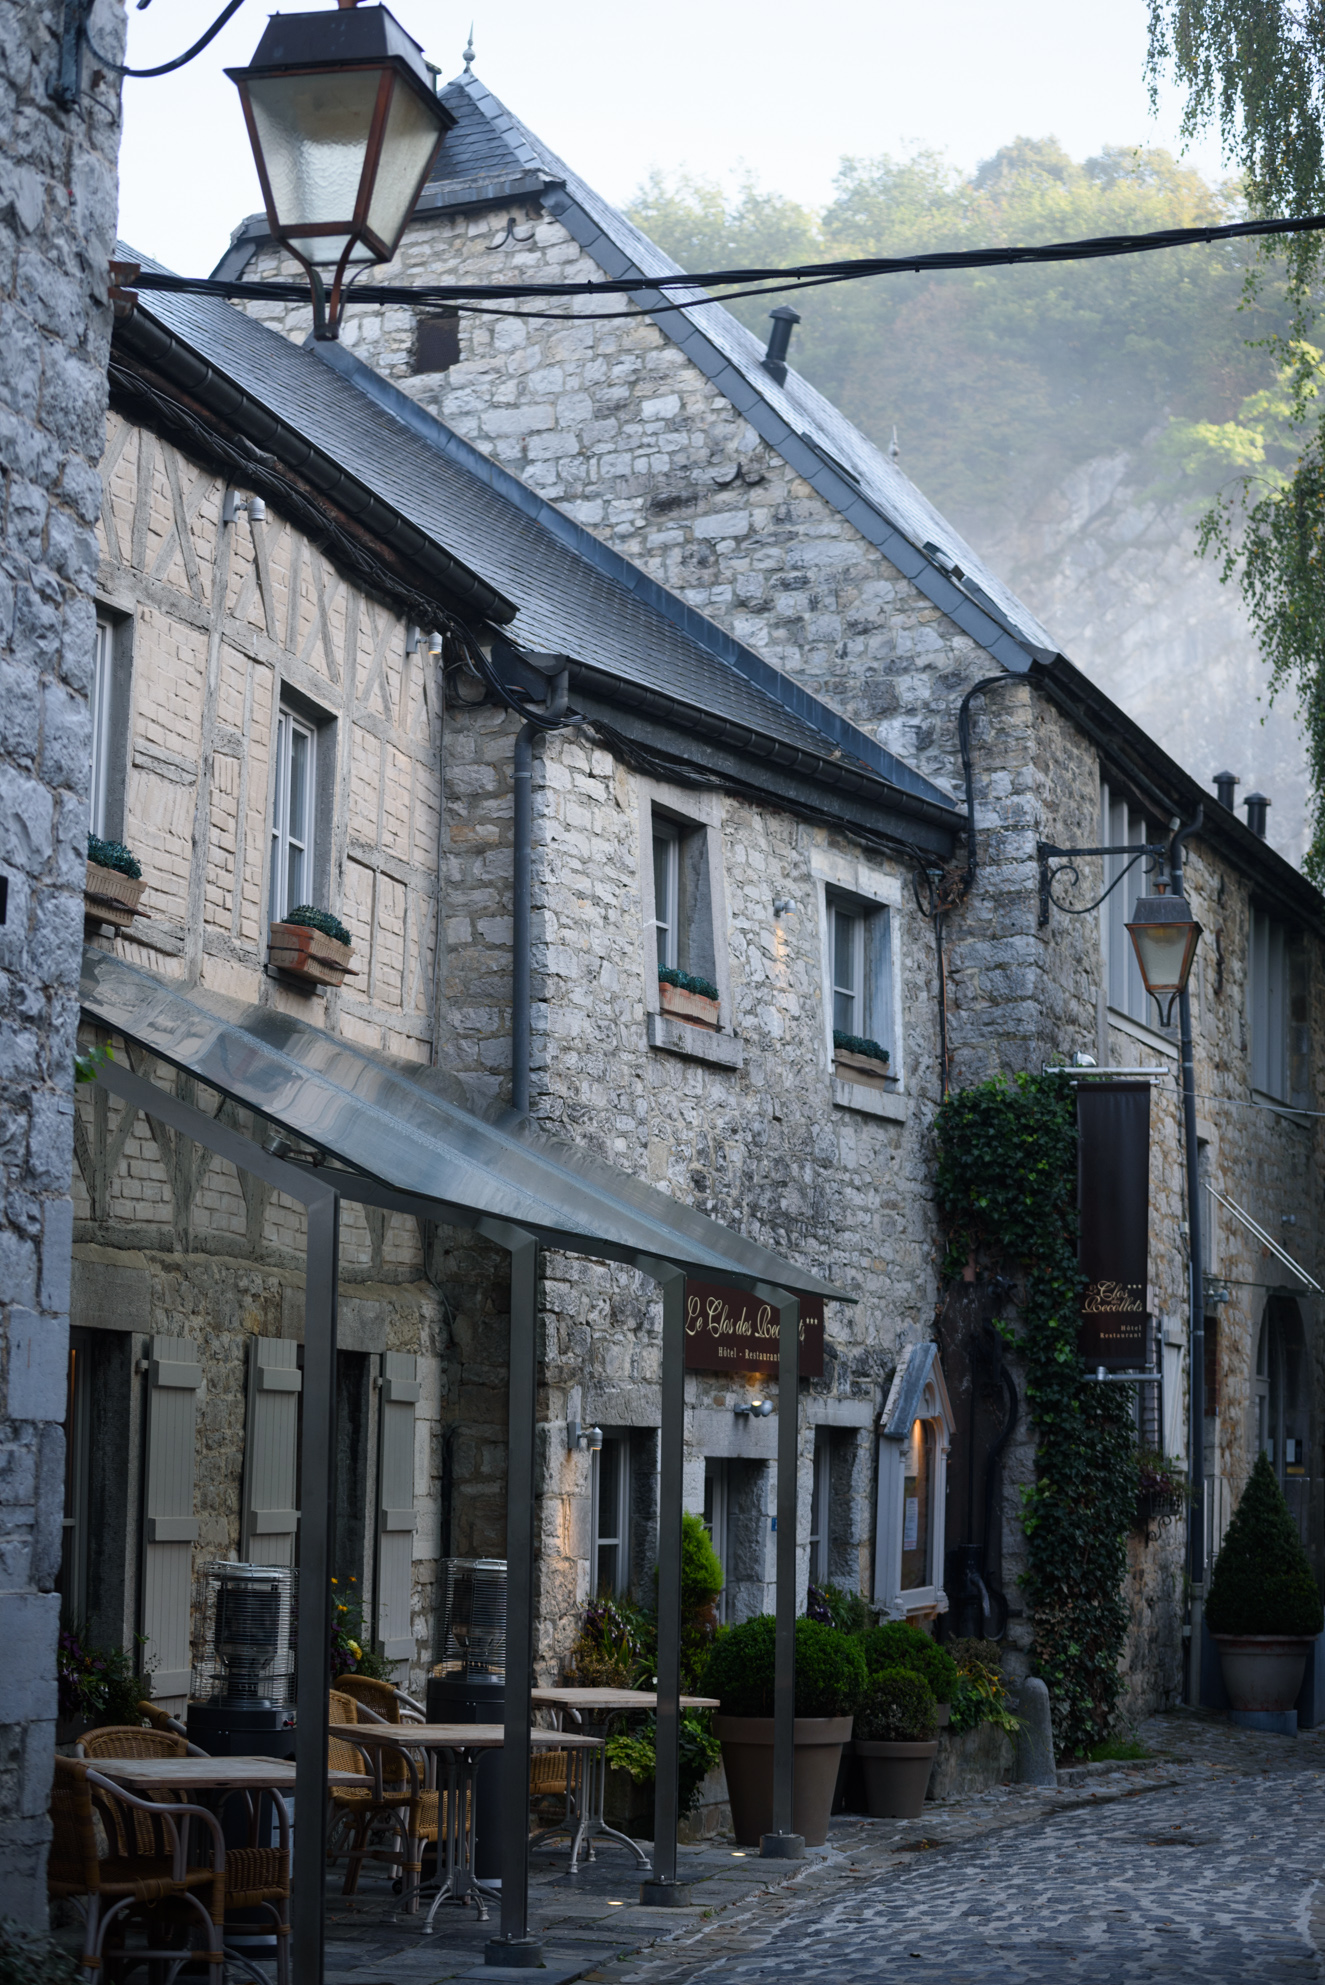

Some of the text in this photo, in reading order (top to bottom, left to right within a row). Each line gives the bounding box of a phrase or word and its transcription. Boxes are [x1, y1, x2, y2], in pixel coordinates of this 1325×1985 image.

[1097, 1280, 1128, 1301] Clos
[1081, 1295, 1143, 1313] Recollets
[685, 1295, 703, 1336] Le
[707, 1296, 734, 1338] Clos
[736, 1306, 753, 1336] des
[718, 1346, 737, 1358] Hôtel
[745, 1348, 780, 1361] Restaurant
